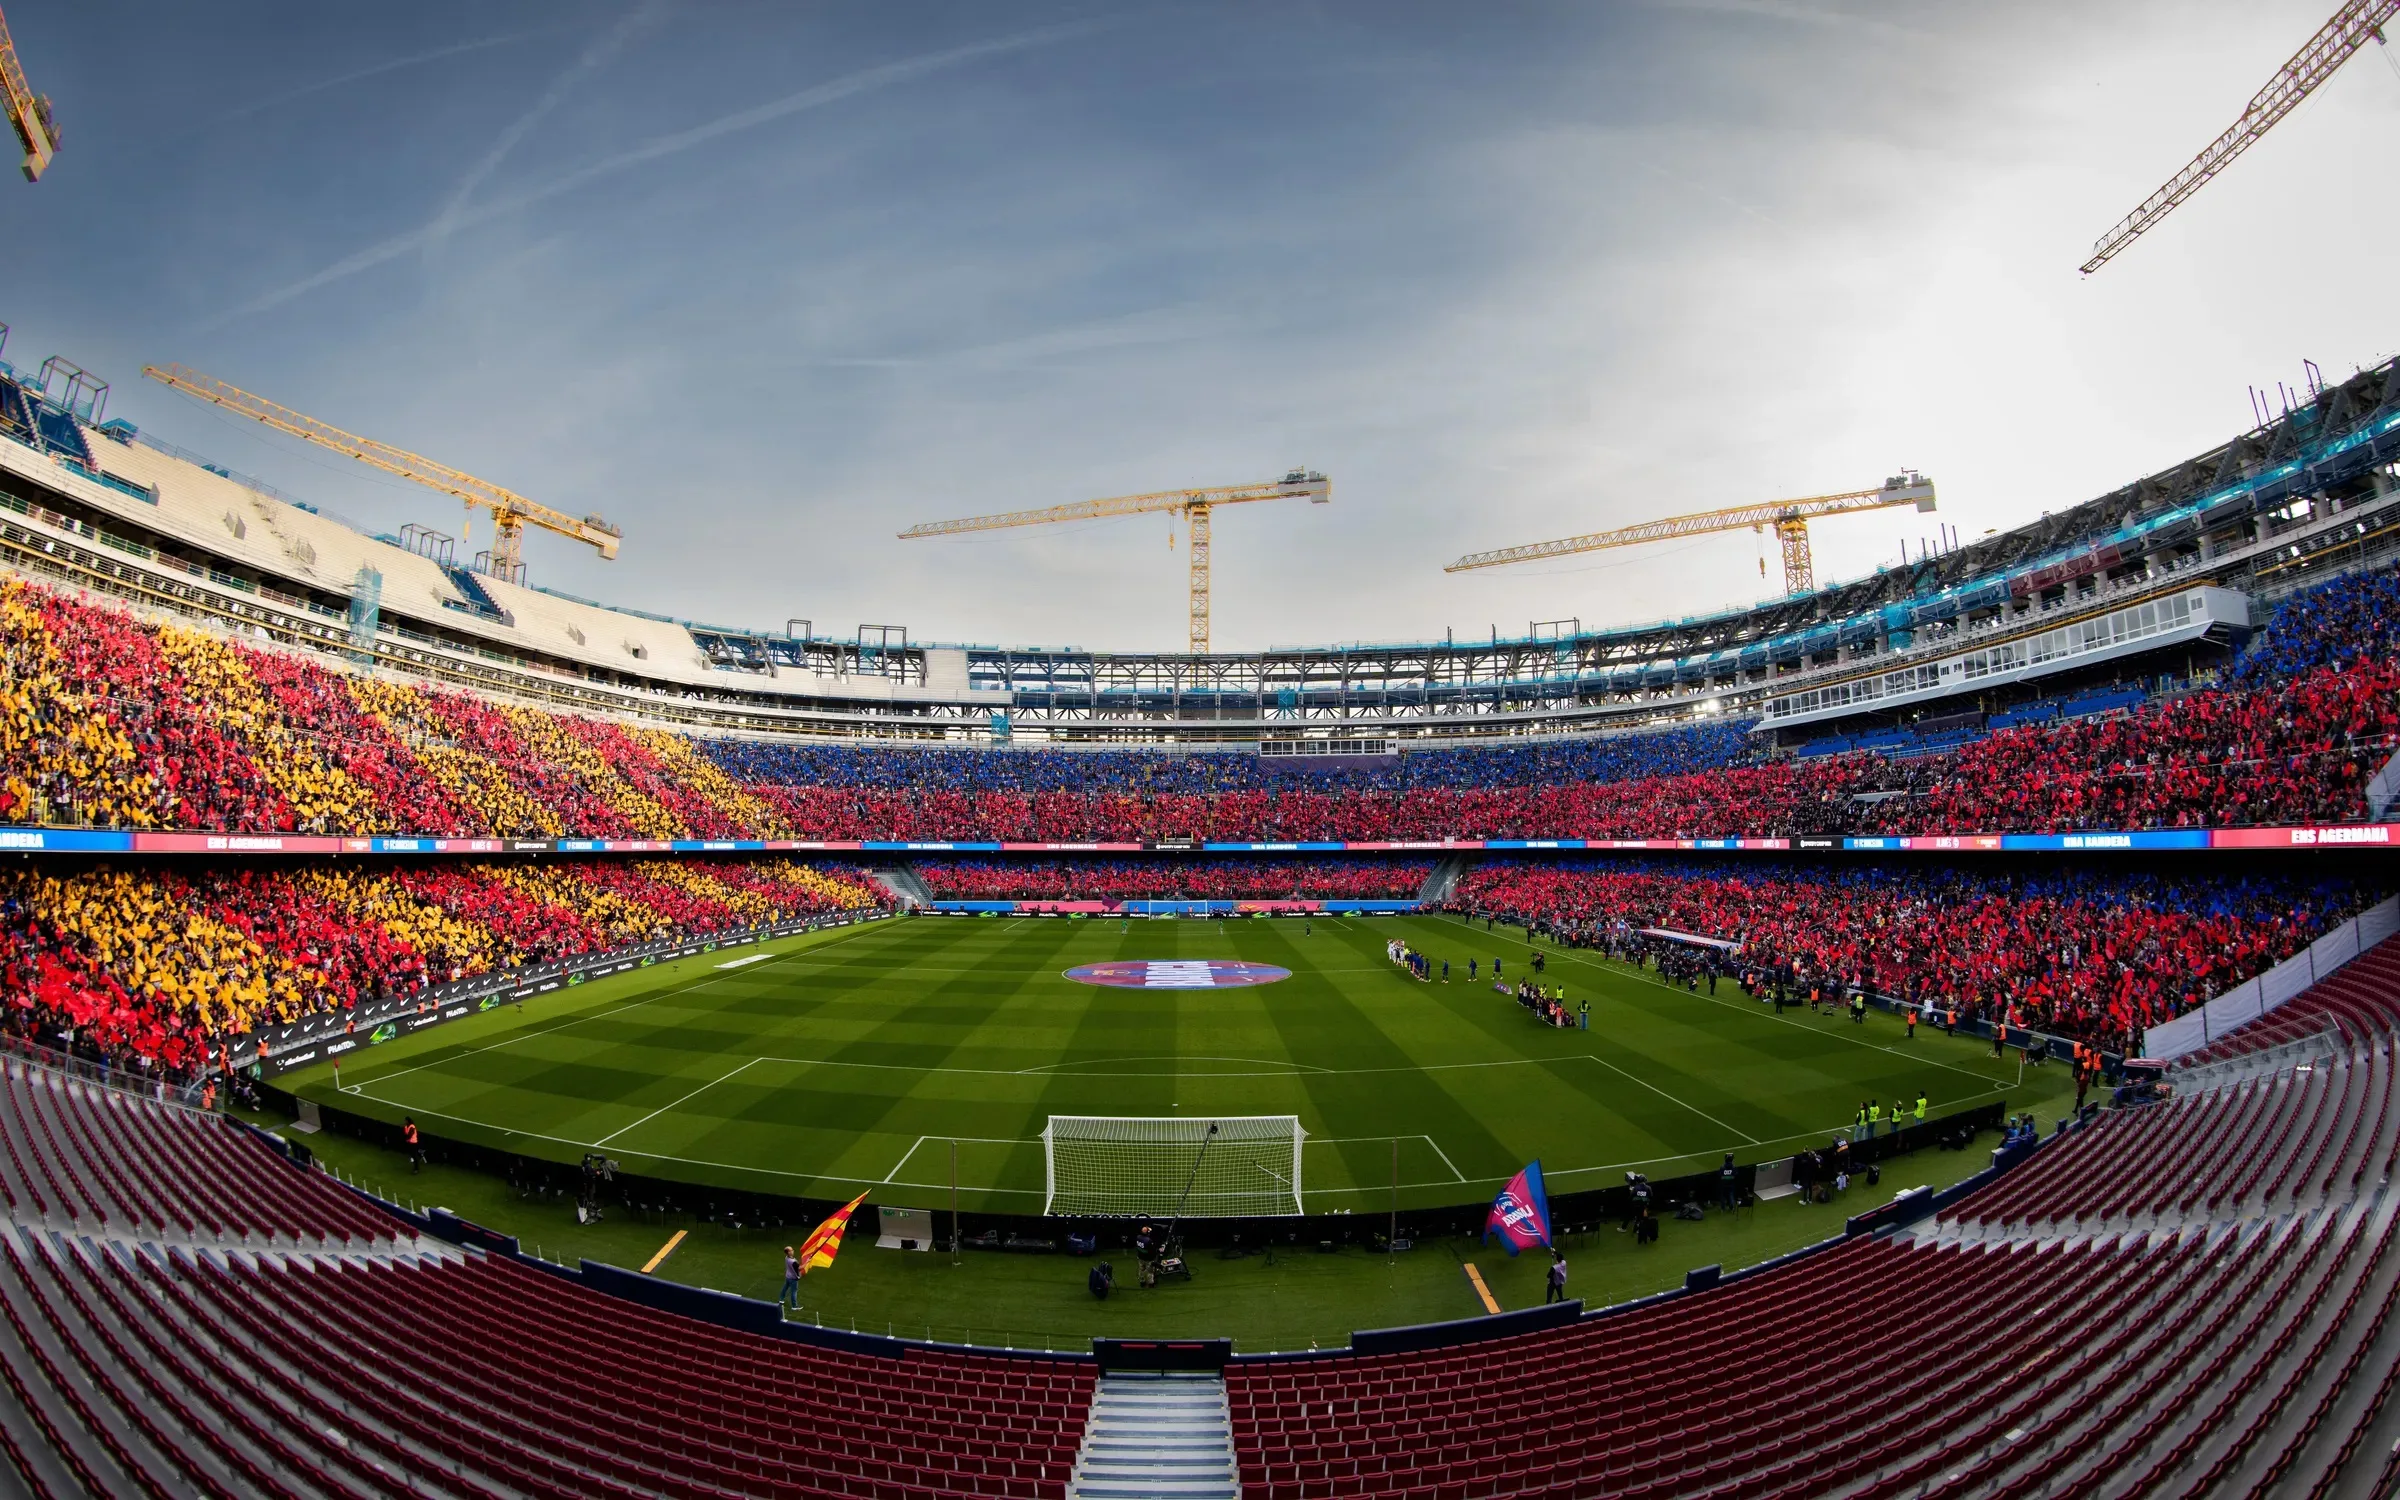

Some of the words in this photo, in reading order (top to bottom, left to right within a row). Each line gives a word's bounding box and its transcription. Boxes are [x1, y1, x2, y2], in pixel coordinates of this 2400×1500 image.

[2063, 837, 2084, 847] UNA
[2085, 836, 2131, 847] BANDERA
[2291, 829, 2316, 843] ENS
[2318, 827, 2389, 843] AGERMANA
